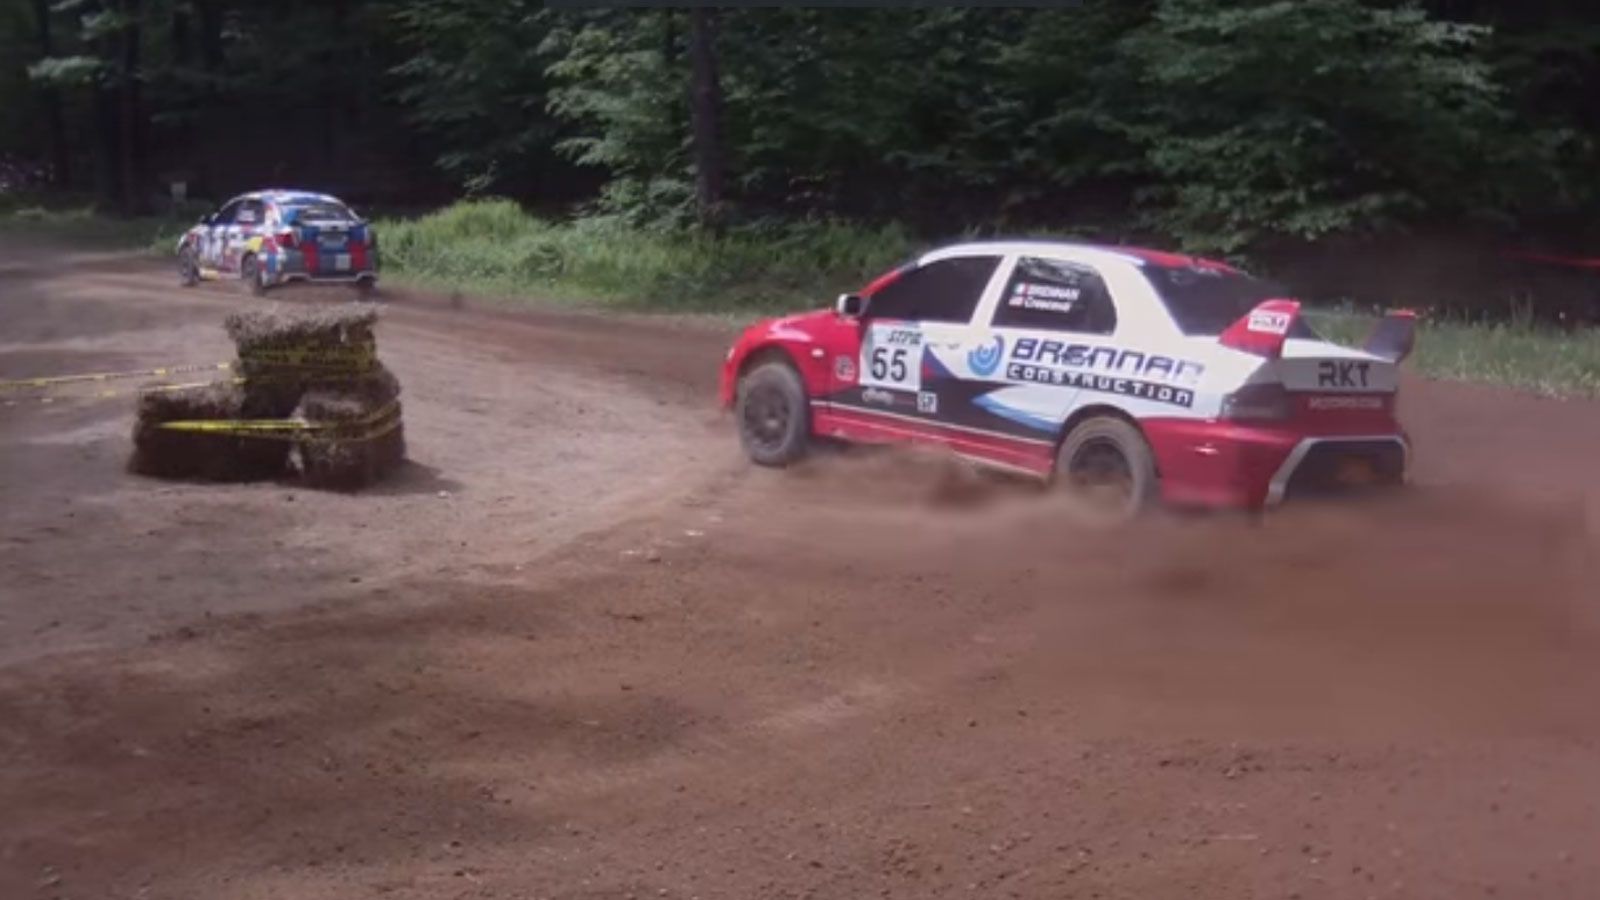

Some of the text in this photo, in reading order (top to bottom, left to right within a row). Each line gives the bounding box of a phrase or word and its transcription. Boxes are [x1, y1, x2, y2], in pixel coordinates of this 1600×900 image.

[1011, 337, 1205, 382] BRENNAN
[1318, 361, 1370, 387] RKT
[1008, 363, 1192, 405] CONSTRUCTION
